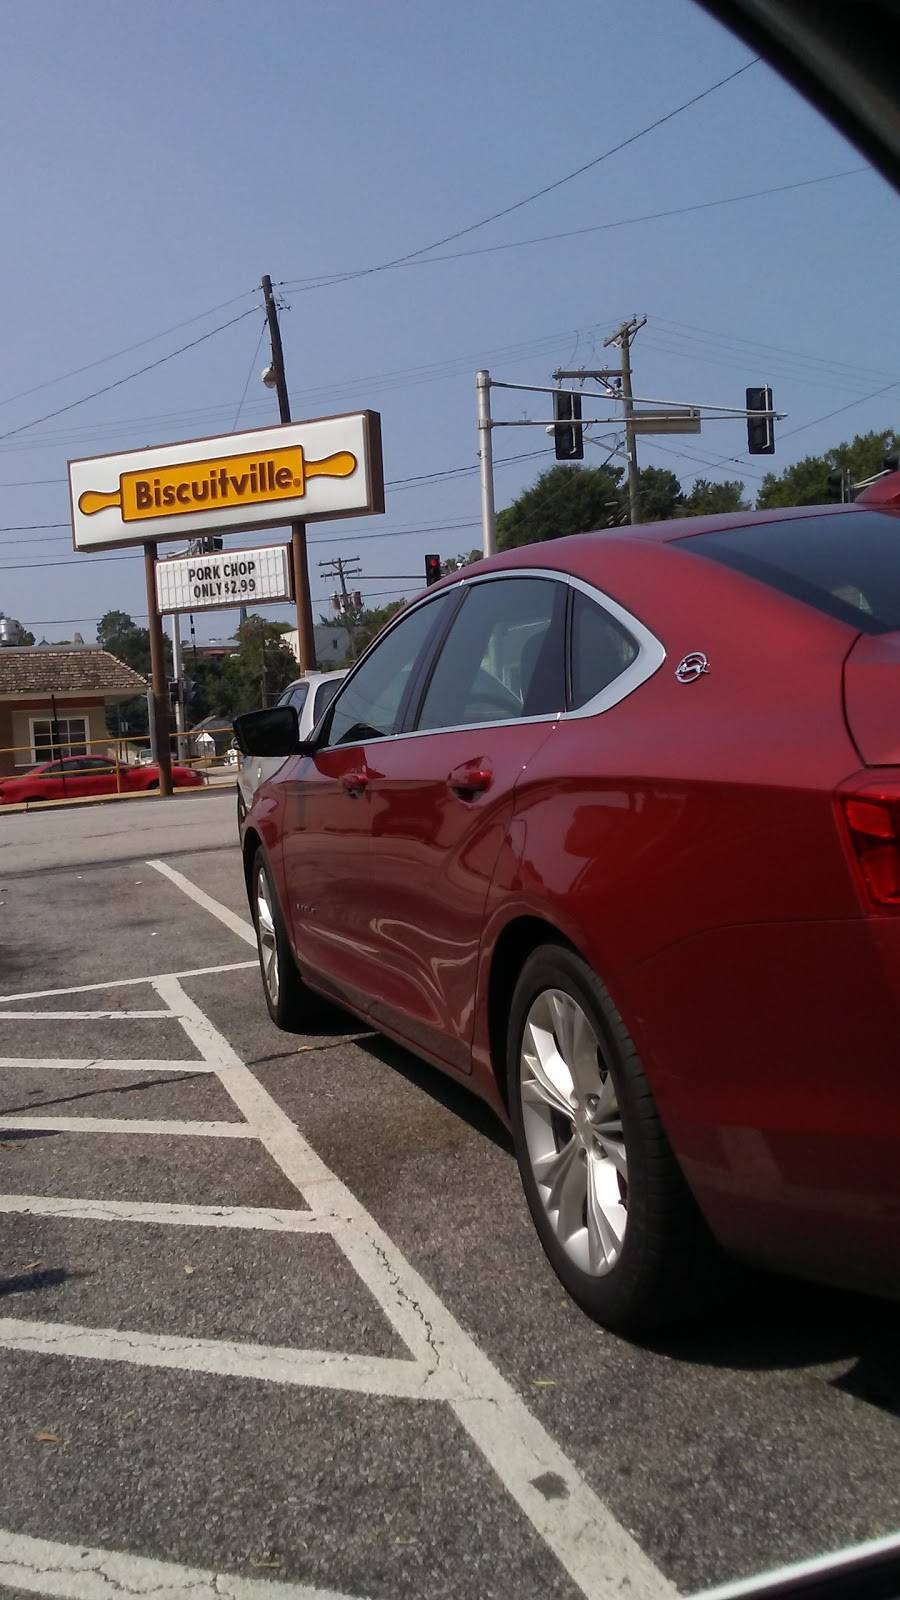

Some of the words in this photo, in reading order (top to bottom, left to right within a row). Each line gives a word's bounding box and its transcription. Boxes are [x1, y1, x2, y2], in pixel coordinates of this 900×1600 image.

[188, 565, 221, 583] PORK
[223, 561, 256, 578] CHOP
[193, 582, 222, 599] ONLY
[224, 578, 256, 595] $2.99
